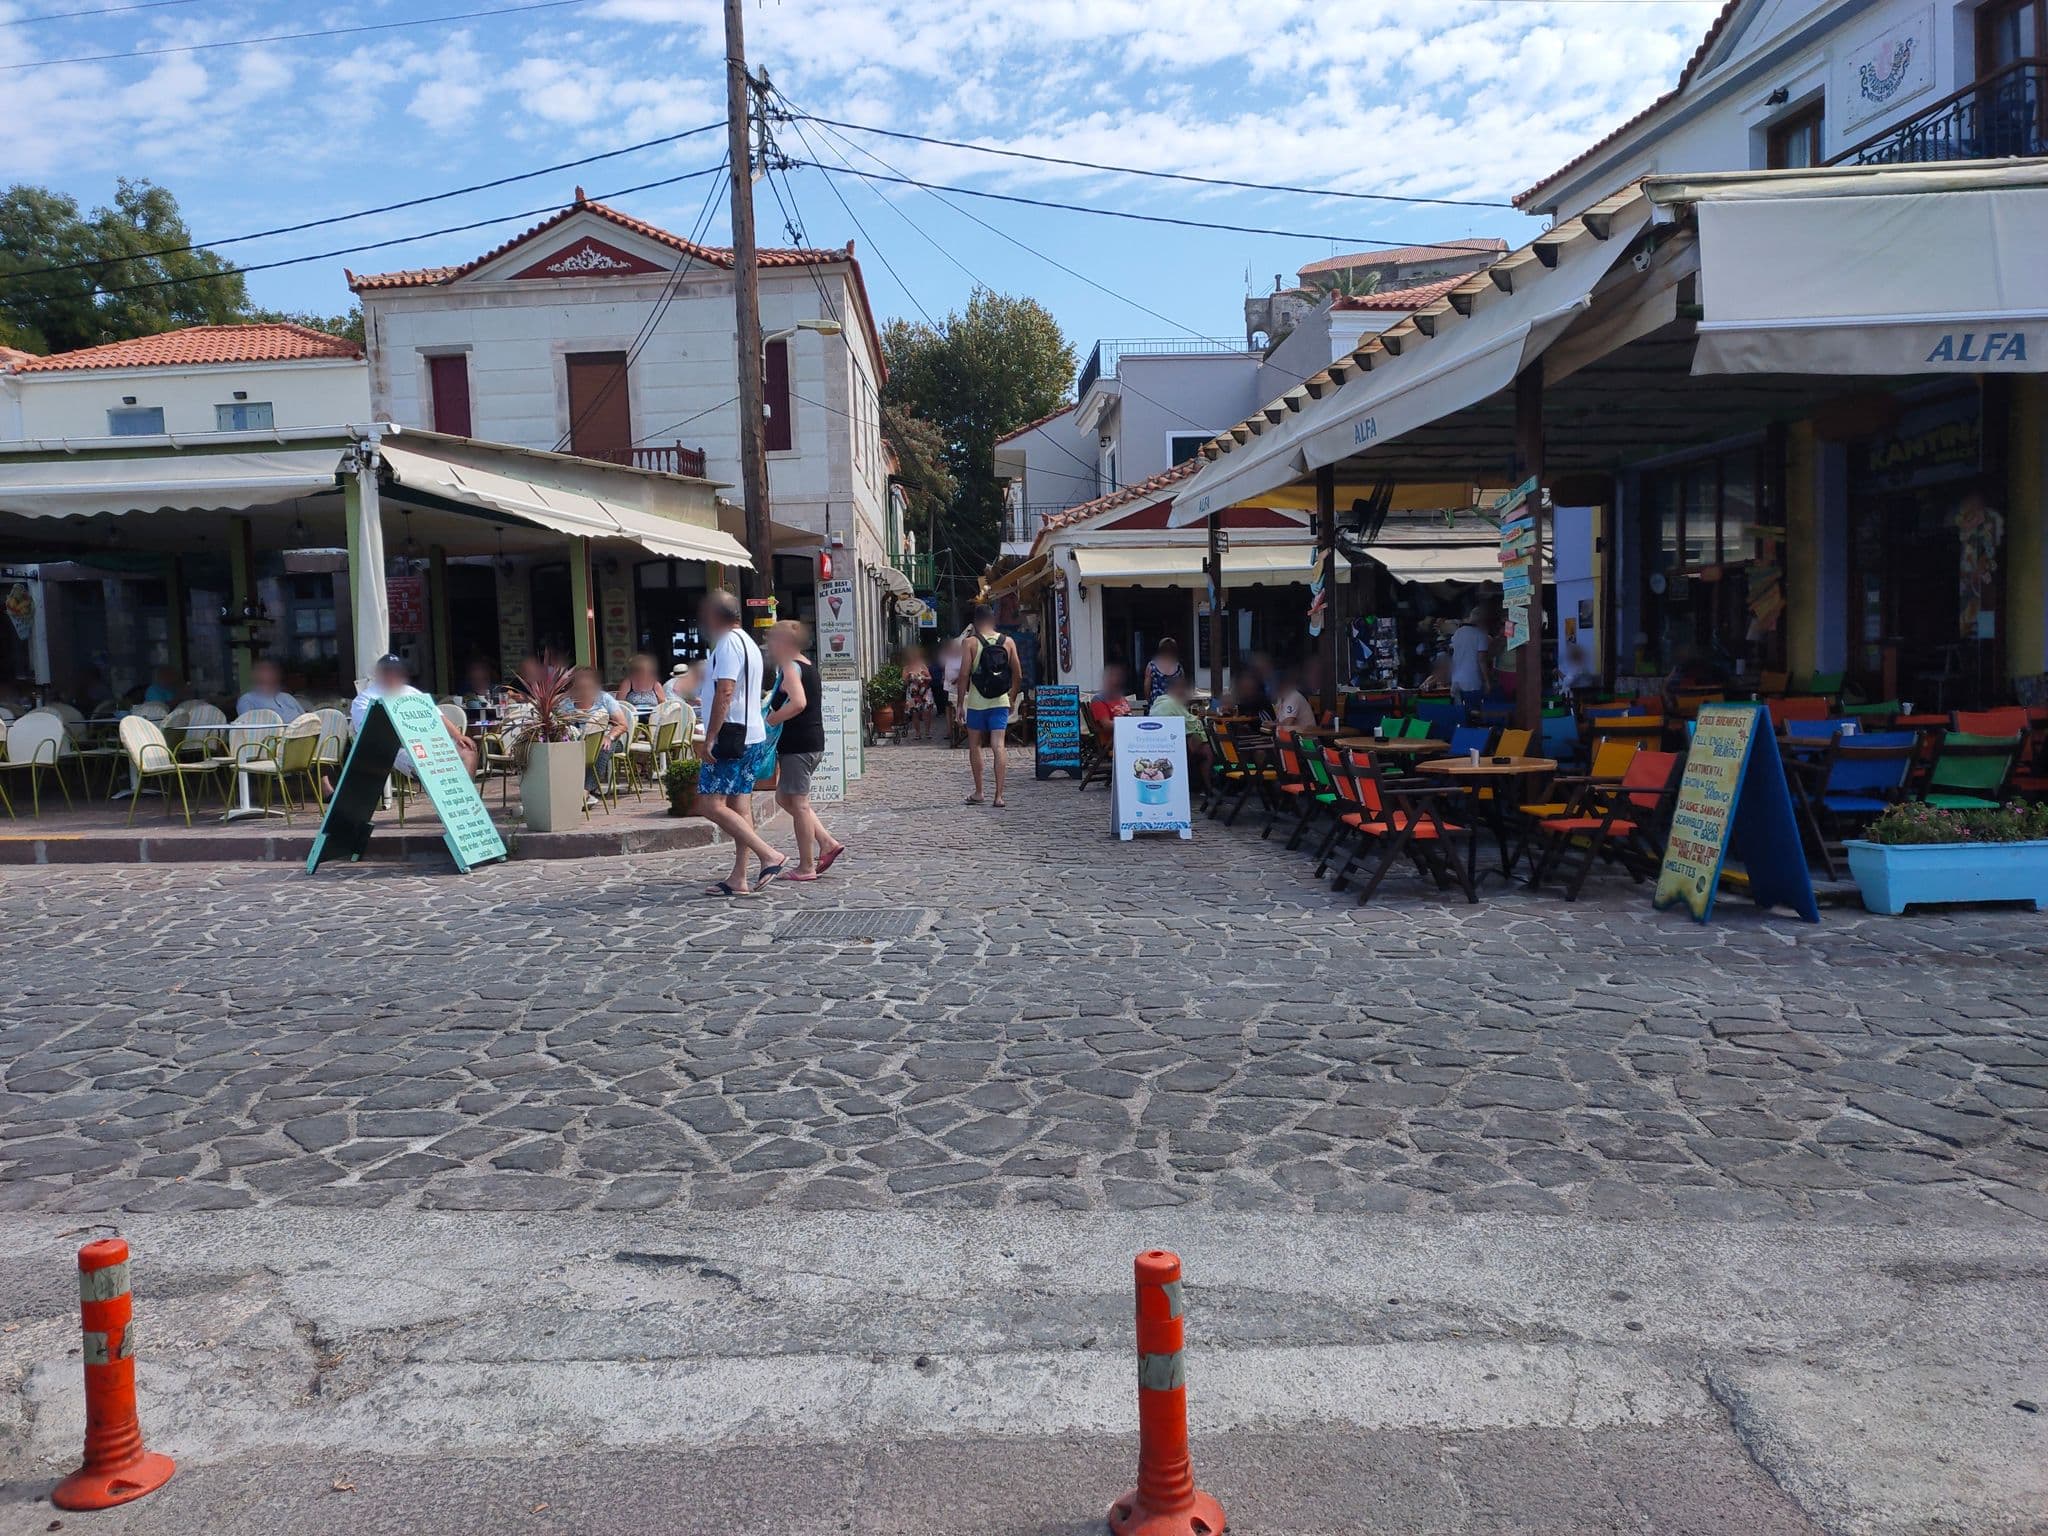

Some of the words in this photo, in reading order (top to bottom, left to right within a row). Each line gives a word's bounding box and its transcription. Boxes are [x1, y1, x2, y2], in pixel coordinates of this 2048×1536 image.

[1926, 332, 2028, 363] ALFA
[1354, 417, 1378, 445] ALFA
[1198, 495, 1210, 513] ALFA
[830, 587, 851, 595] CREAM
[399, 709, 433, 720] TSALIKIS
[1715, 716, 1747, 728] BREAKFAST
[1665, 859, 1697, 878] OMELETTES
